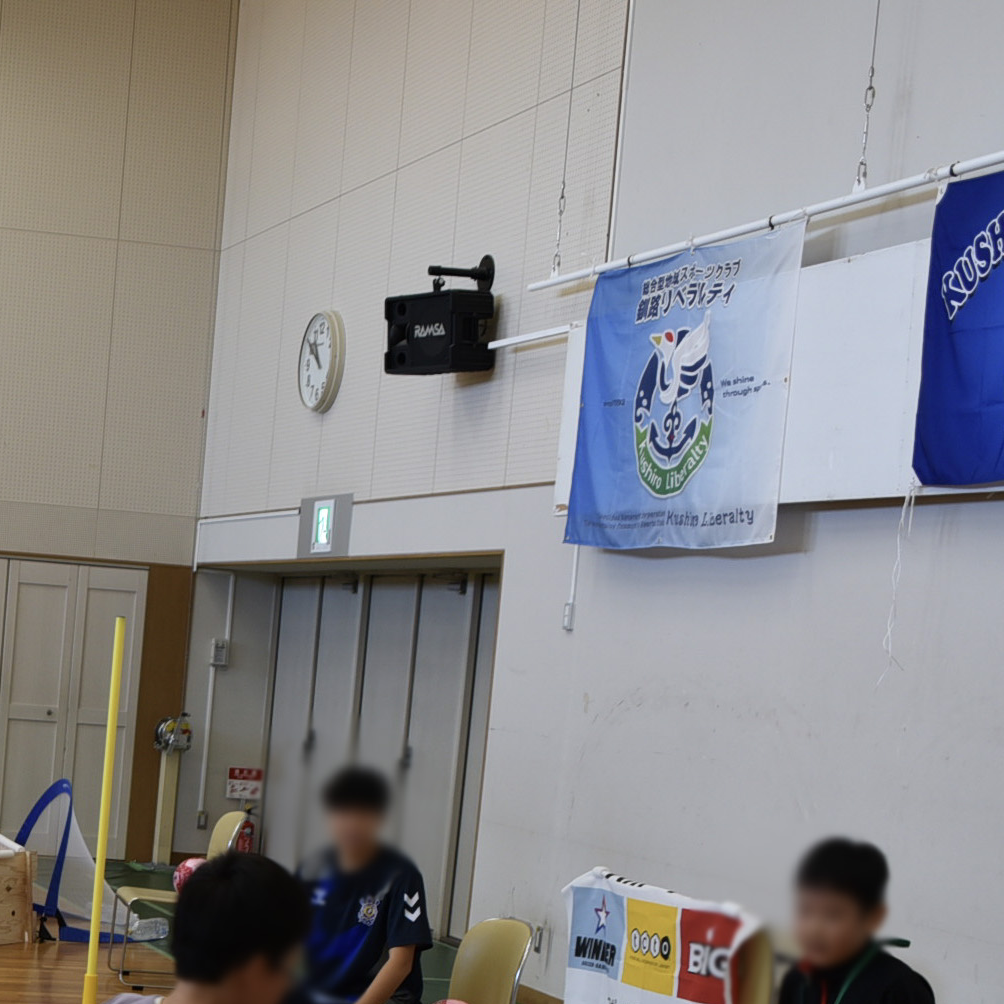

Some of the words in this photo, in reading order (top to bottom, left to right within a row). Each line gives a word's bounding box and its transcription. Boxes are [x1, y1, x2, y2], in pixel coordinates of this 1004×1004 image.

[414, 322, 446, 338] RAMSA
[733, 376, 754, 385] shine
[723, 386, 752, 398] through
[638, 440, 662, 490] Kushiro
[665, 435, 709, 490] Liberalty
[688, 942, 728, 980] BIG
